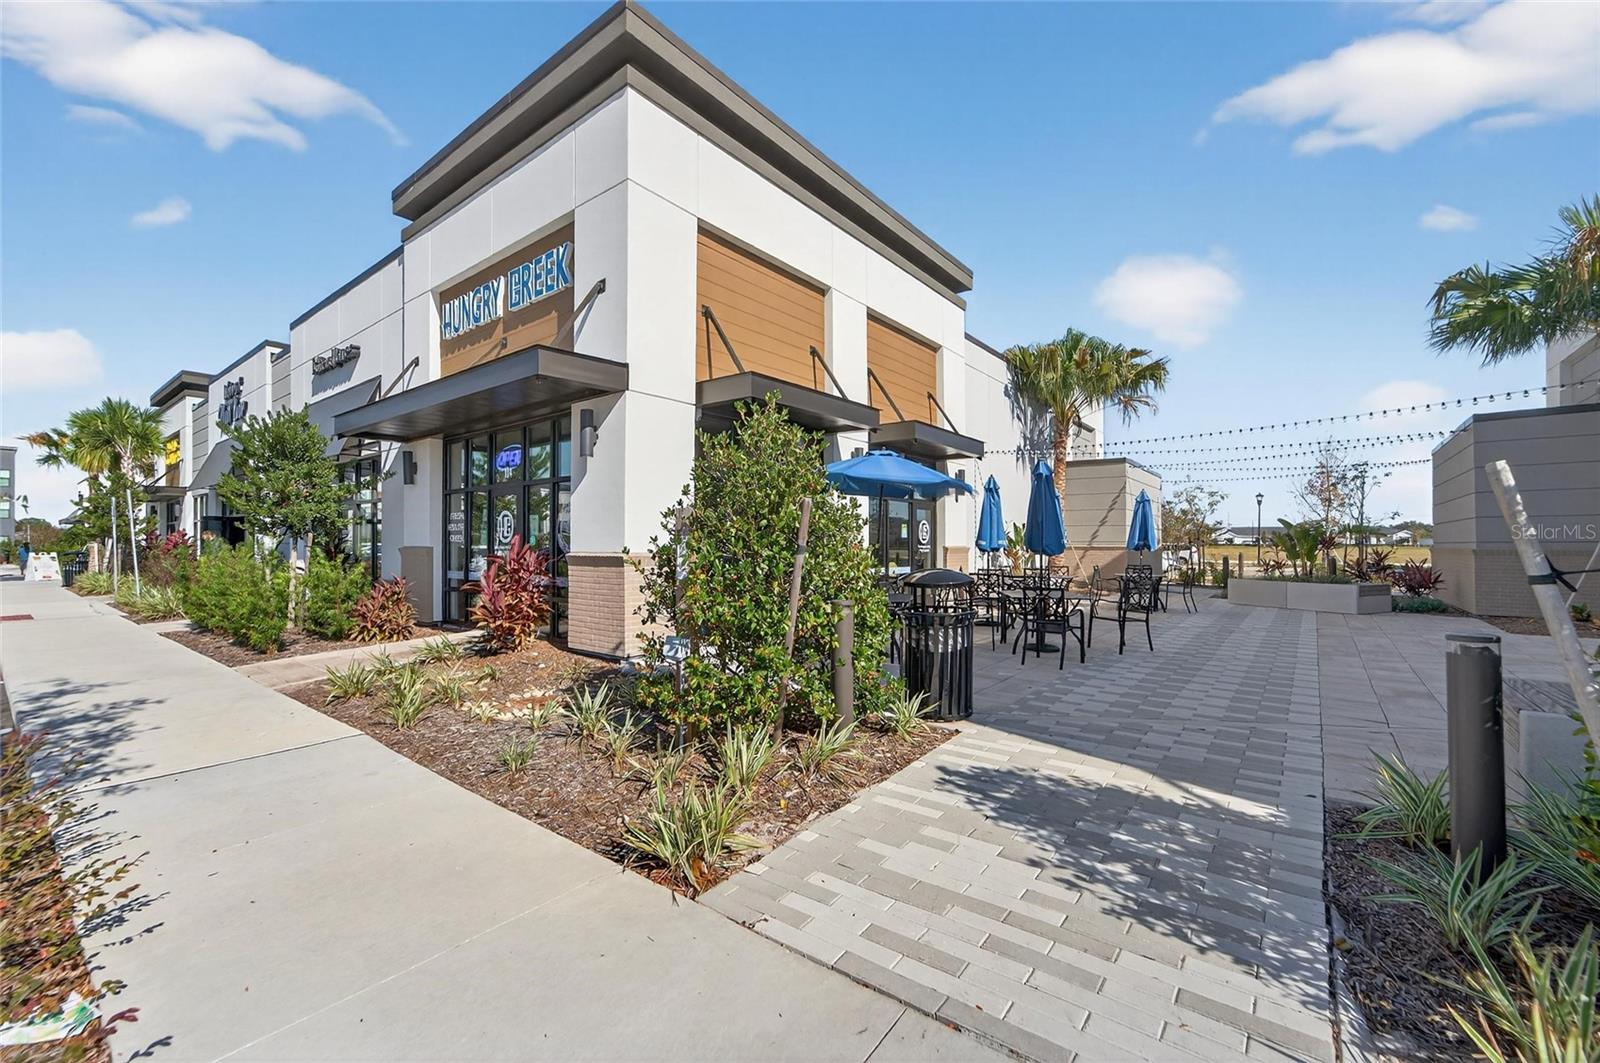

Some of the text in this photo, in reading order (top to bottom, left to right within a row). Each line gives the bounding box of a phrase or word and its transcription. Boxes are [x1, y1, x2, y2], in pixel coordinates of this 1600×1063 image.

[441, 240, 573, 340] HUNGRY GREEK
[497, 450, 521, 467] OPEN
